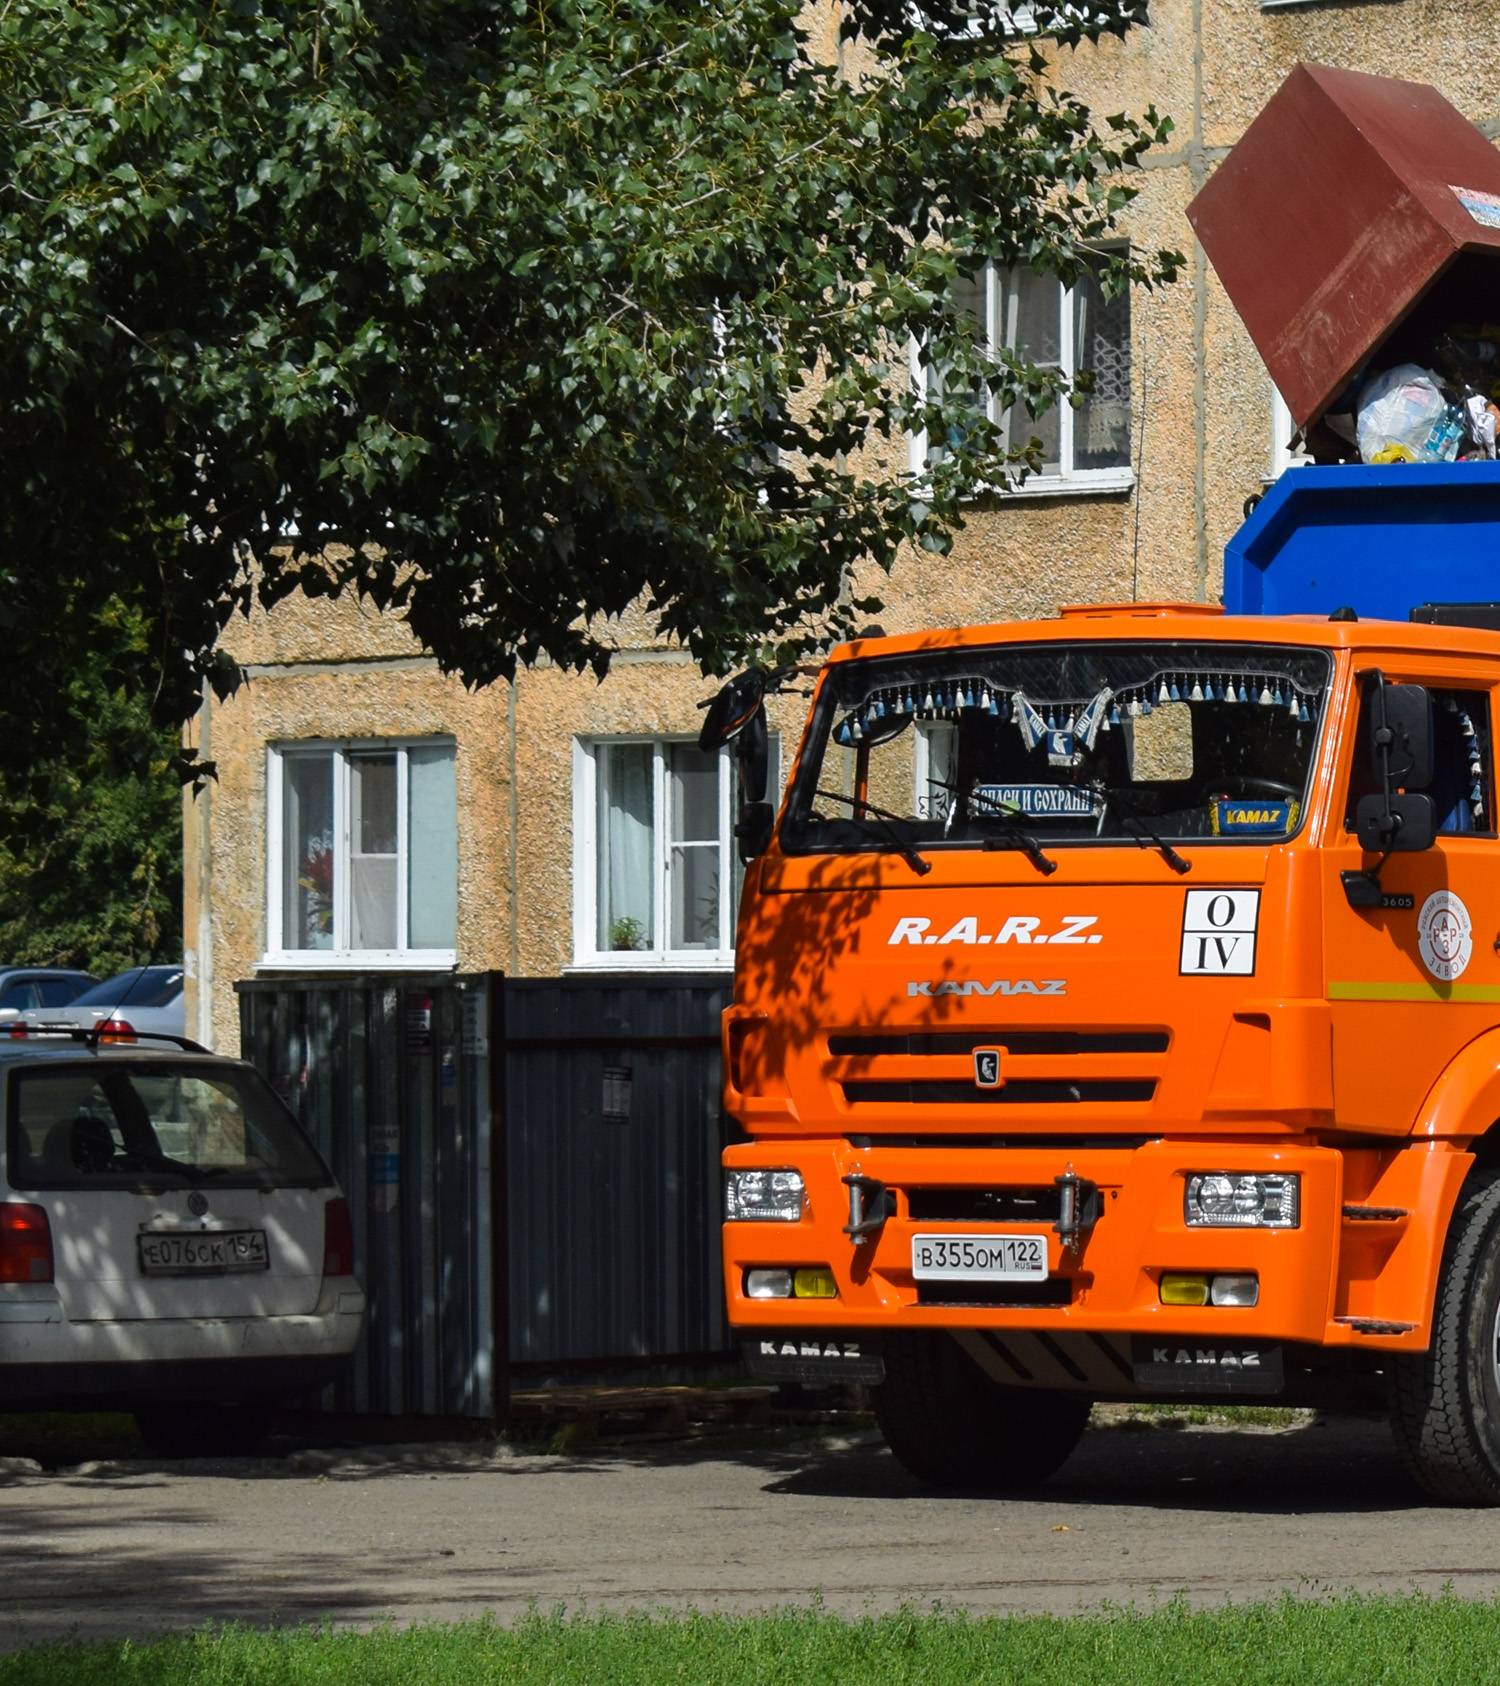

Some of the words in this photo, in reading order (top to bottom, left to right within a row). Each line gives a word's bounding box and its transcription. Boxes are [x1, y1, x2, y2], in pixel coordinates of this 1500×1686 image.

[1225, 810, 1281, 825] KAMAZ
[887, 915, 1104, 945] R.A.R.Z.
[1194, 936, 1241, 970] IV
[907, 979, 1067, 997] KAMAZ
[1007, 1241, 1039, 1262] 122
[1014, 1262, 1031, 1270] RUS
[760, 1341, 861, 1357] KAMAZ
[1153, 1348, 1260, 1366] KAMAZ
